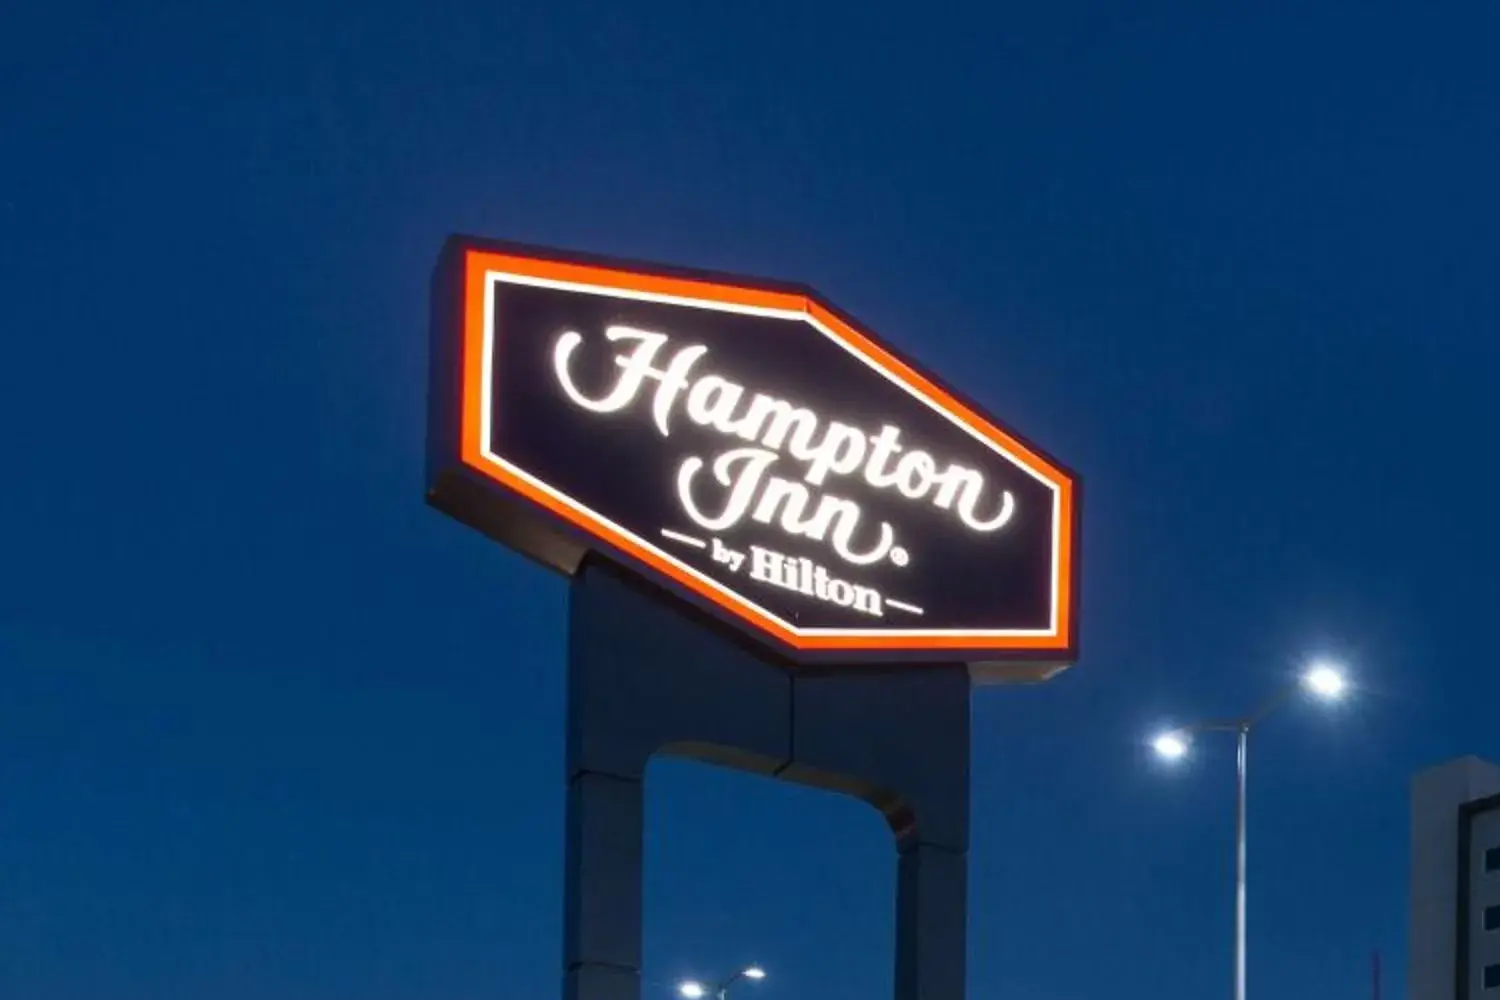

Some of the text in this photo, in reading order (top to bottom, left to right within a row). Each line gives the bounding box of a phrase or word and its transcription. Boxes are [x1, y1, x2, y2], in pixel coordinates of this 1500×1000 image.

[554, 326, 1014, 532] Hampton
[711, 537, 884, 616] by Hilton
